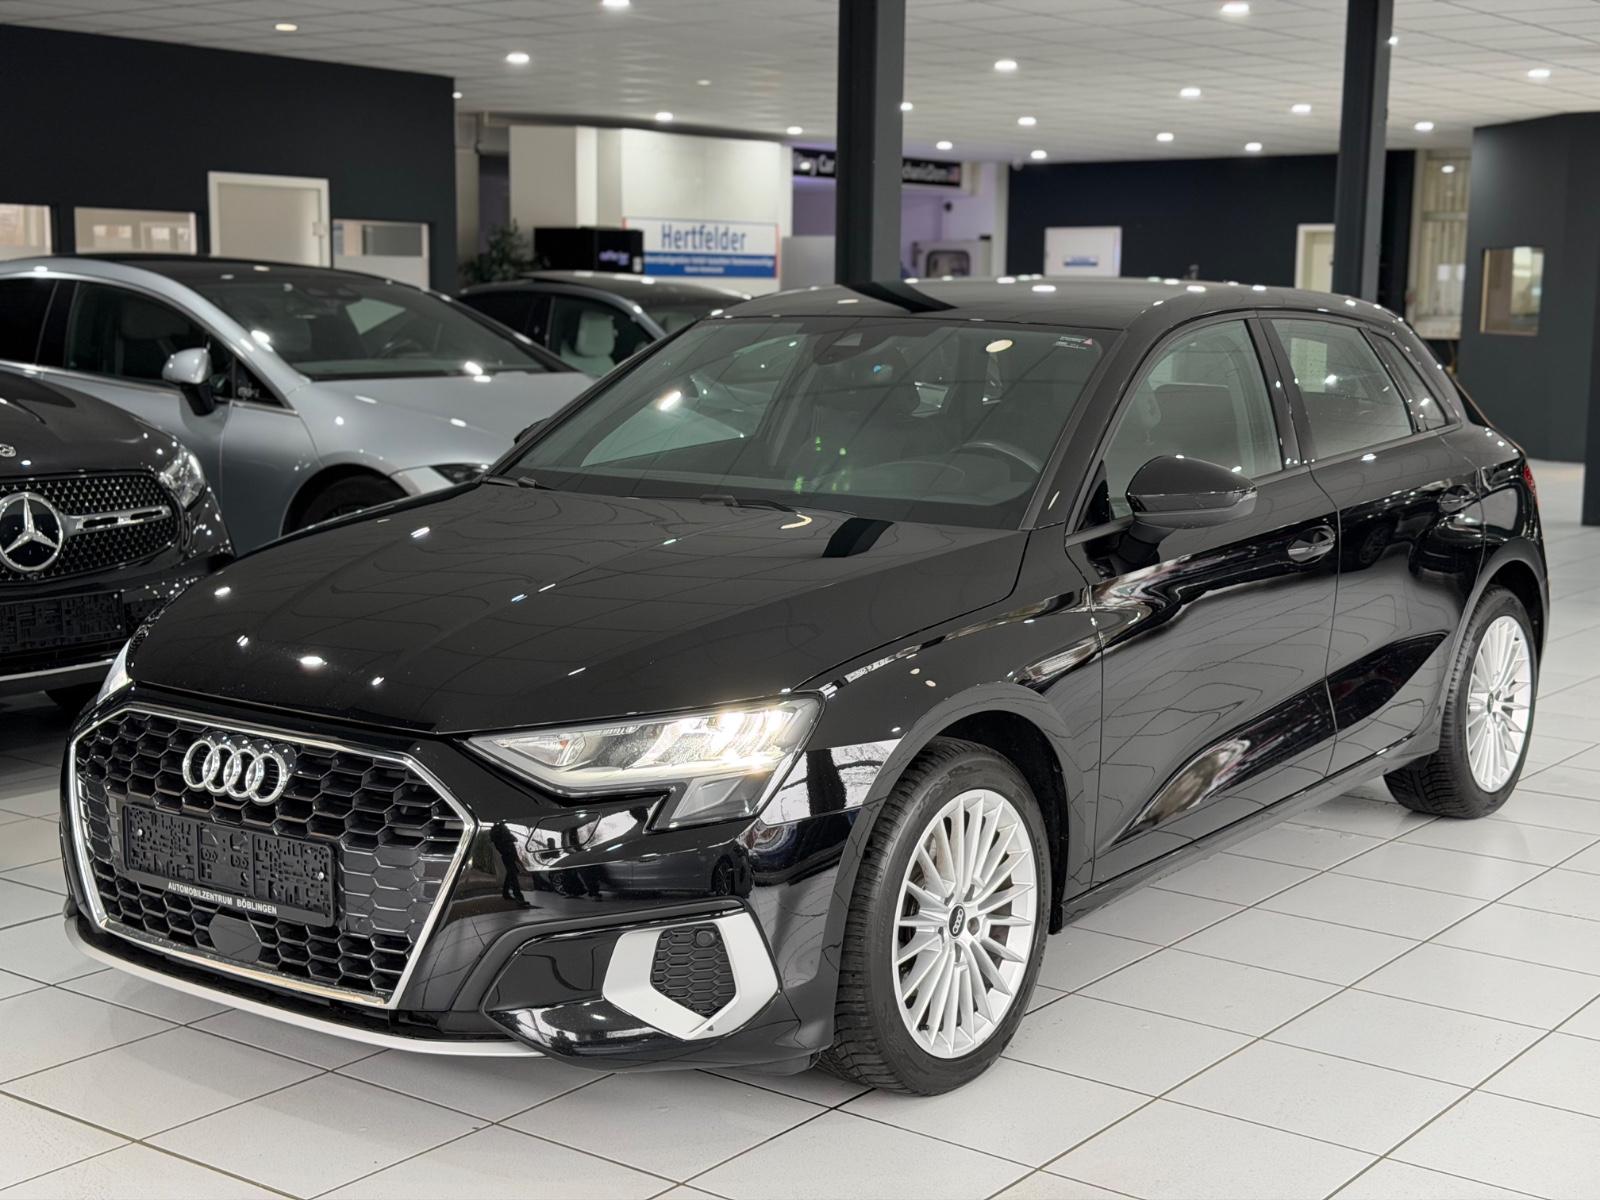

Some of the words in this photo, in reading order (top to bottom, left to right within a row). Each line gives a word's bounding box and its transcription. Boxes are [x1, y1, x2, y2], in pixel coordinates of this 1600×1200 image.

[661, 223, 747, 251] Hertfelder
[168, 881, 233, 906] AUTOMOBILZENTRUM
[237, 898, 278, 915] BÖBLINGEN
